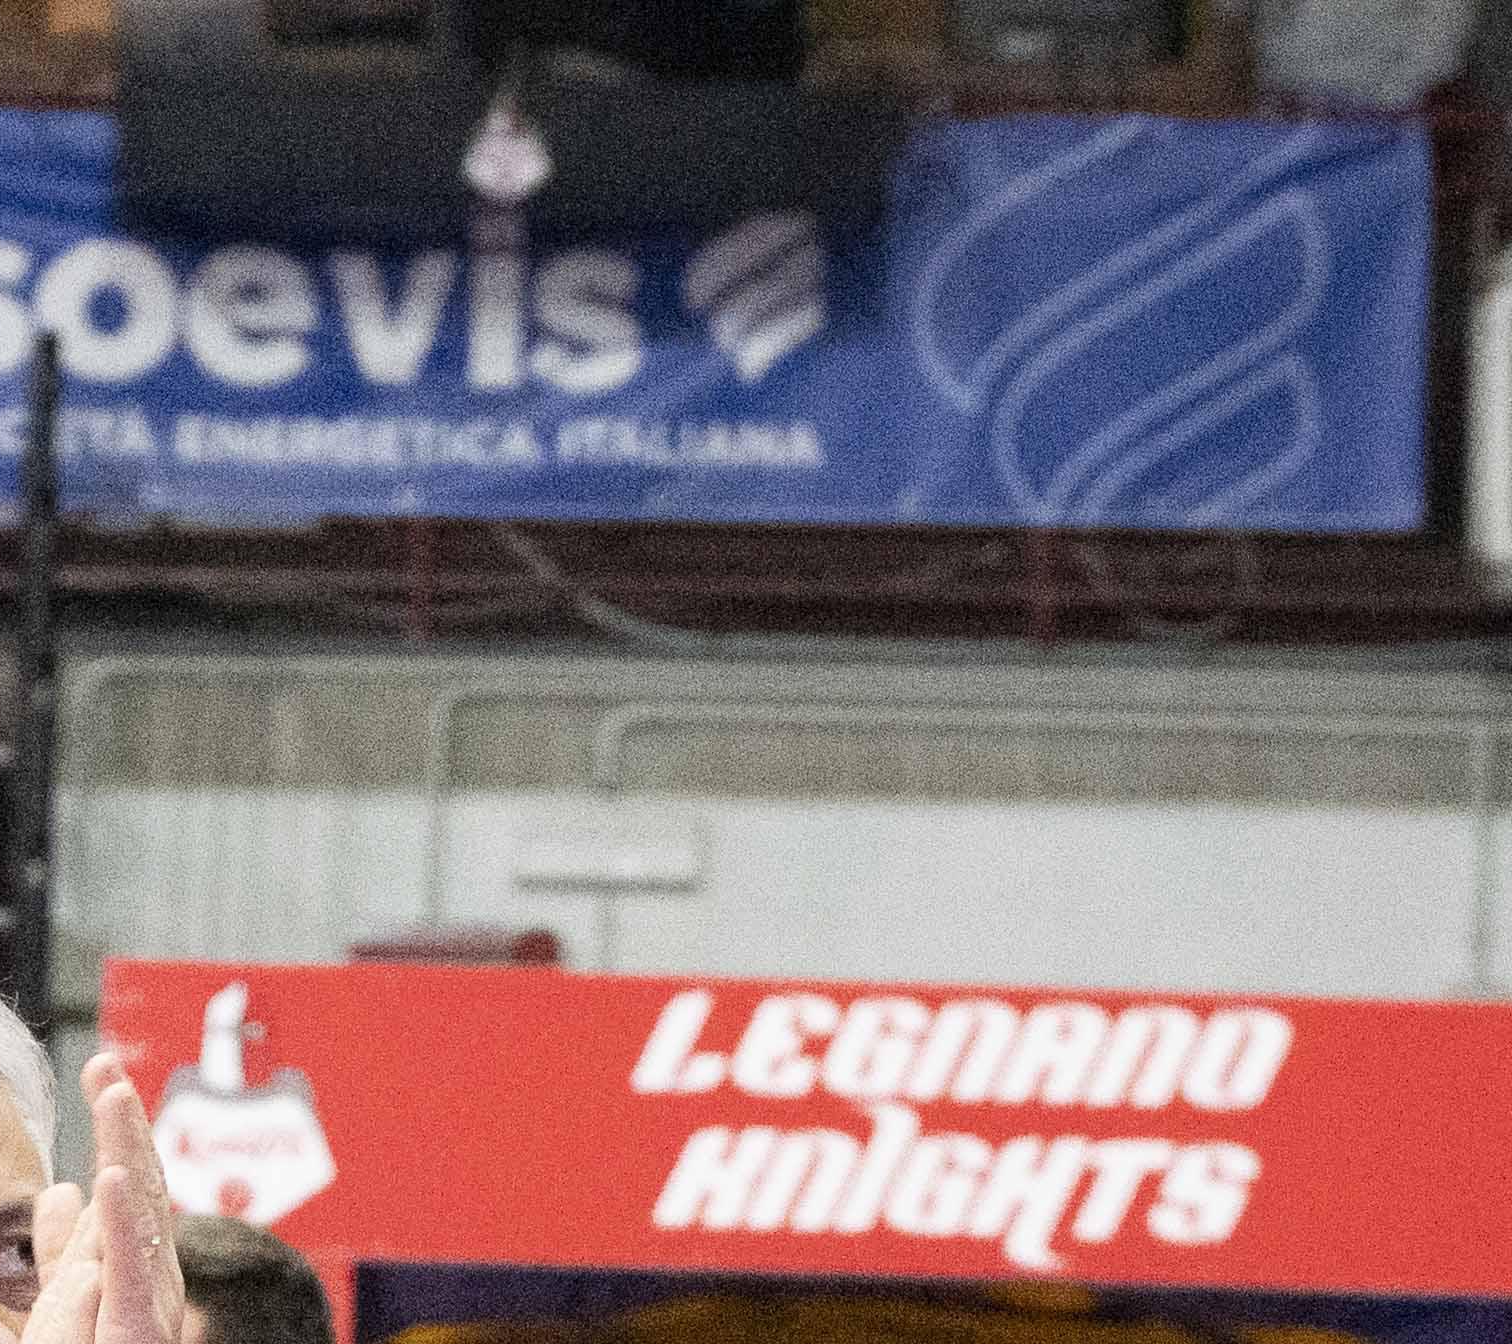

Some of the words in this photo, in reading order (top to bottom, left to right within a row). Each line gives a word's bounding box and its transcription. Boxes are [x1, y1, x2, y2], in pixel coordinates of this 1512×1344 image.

[173, 414, 544, 469] ENERGETICA
[556, 418, 825, 471] ITALIANA
[630, 988, 1293, 1112] LEGNANO
